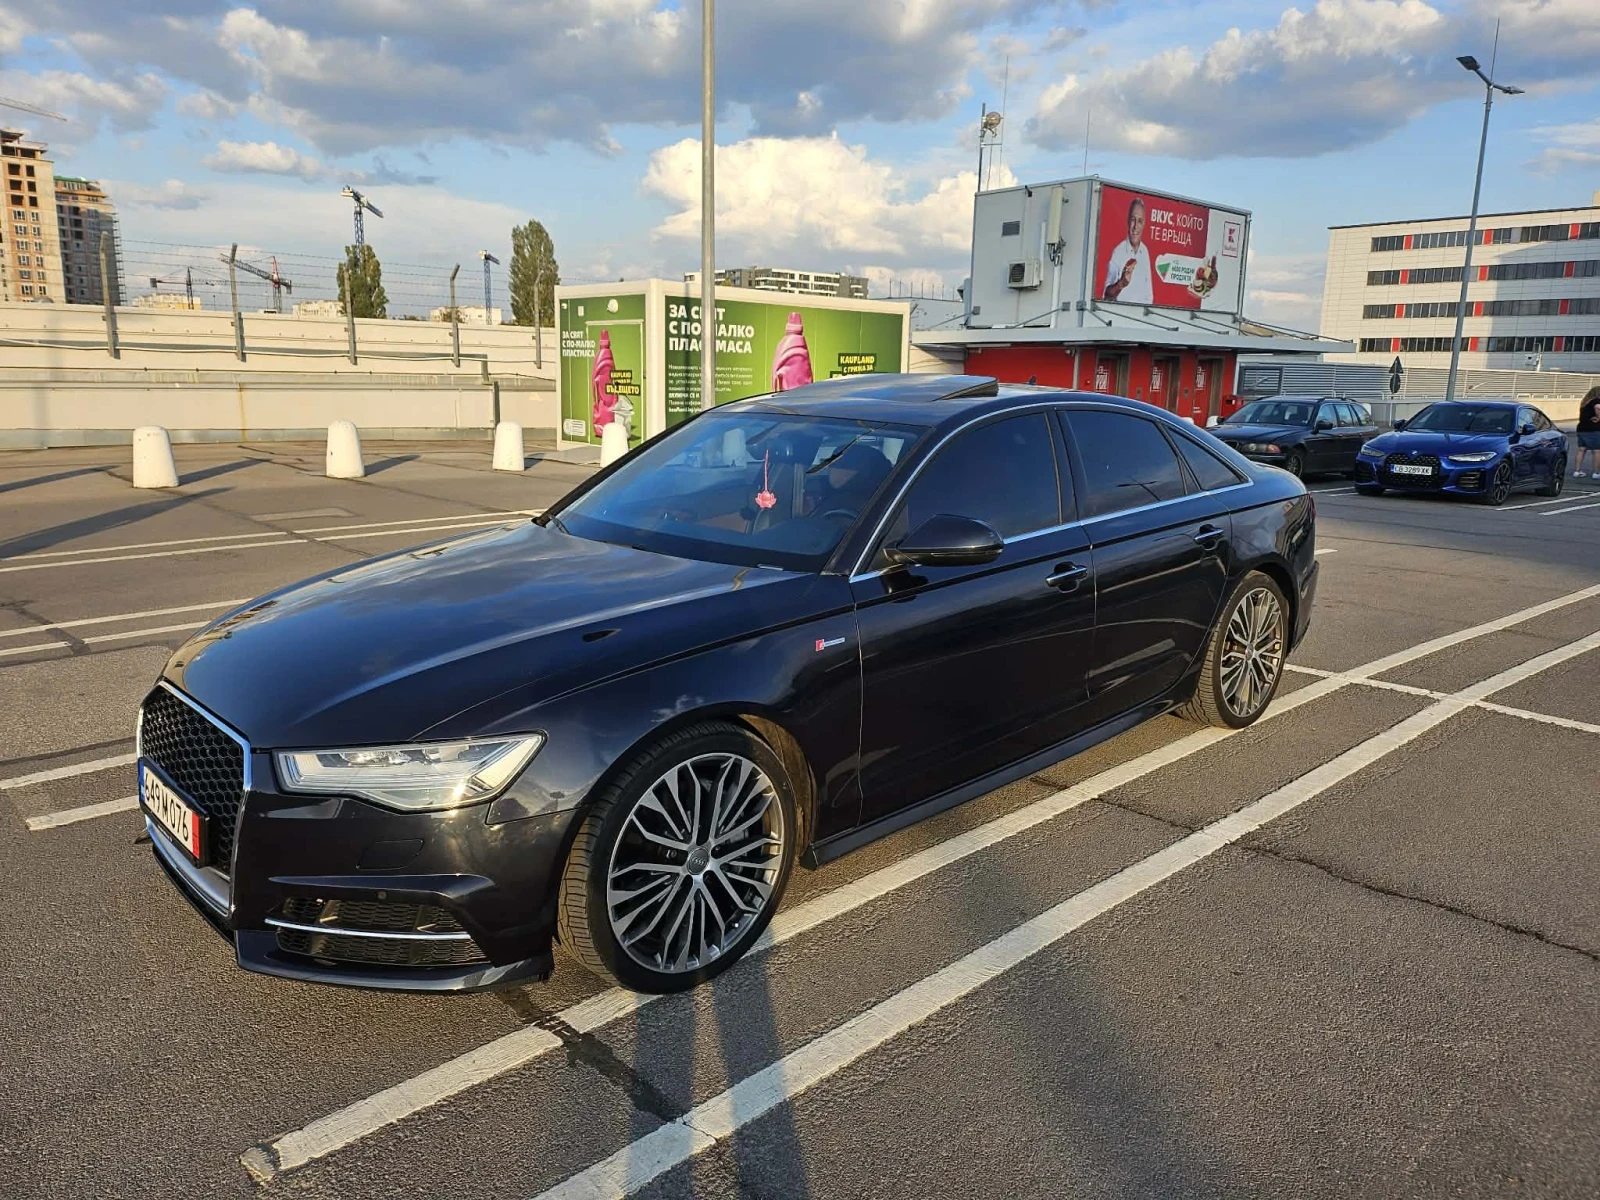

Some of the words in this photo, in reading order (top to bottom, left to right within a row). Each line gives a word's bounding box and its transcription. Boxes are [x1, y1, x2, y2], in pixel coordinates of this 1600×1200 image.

[1151, 209, 1175, 227] ВКУС,
[1177, 213, 1204, 231] КОЙТО
[1150, 226, 1160, 240] ТЕ
[1162, 231, 1192, 246] ВРЪЩА
[669, 304, 687, 319] ЗА
[691, 306, 726, 320] СТ
[562, 331, 570, 339] ЗА
[669, 321, 678, 335] С
[562, 340, 567, 348] С
[840, 355, 874, 364] KAUFLAND
